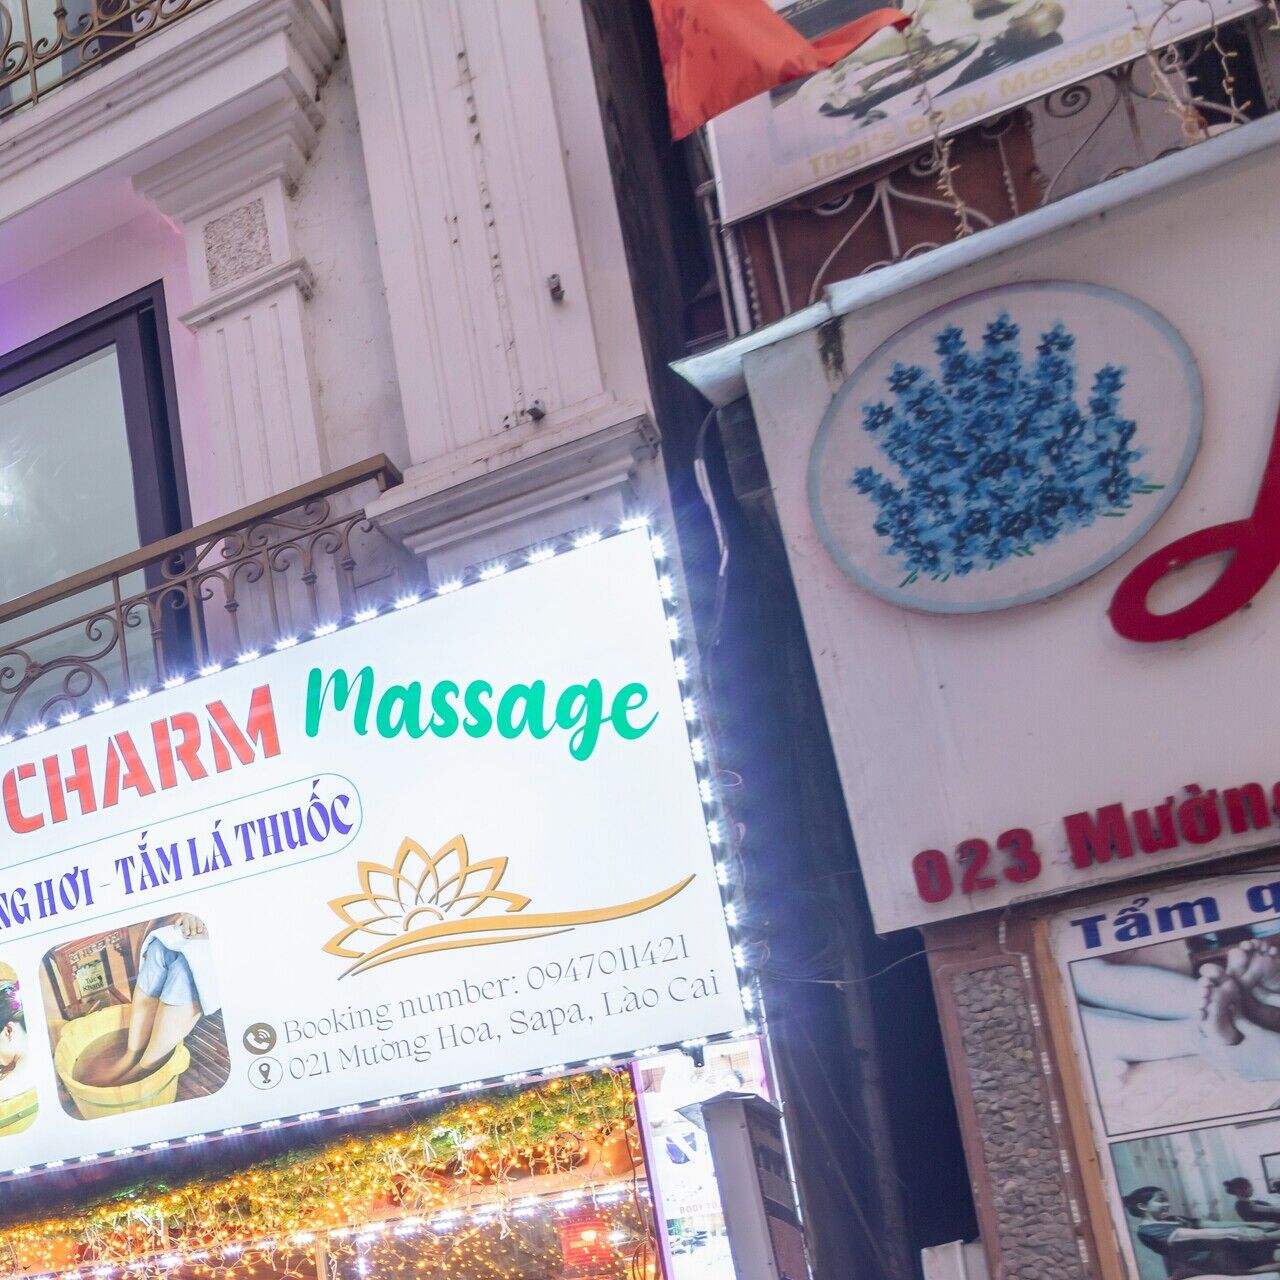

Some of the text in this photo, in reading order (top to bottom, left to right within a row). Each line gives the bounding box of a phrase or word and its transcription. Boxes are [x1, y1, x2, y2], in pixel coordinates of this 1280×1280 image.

[2, 683, 282, 834] CHARM
[305, 664, 659, 761] Massage
[33, 867, 95, 919] HƠI
[114, 831, 184, 896] TẮM
[186, 819, 233, 877] LÁ
[234, 778, 354, 862] THUỐC
[912, 826, 1042, 904] 023
[1069, 896, 1222, 951] Tẩm
[282, 934, 691, 1045] Booking number: 0947011421
[288, 969, 720, 1082] 021 Mường Hoa, Sapa, Lào Cai
